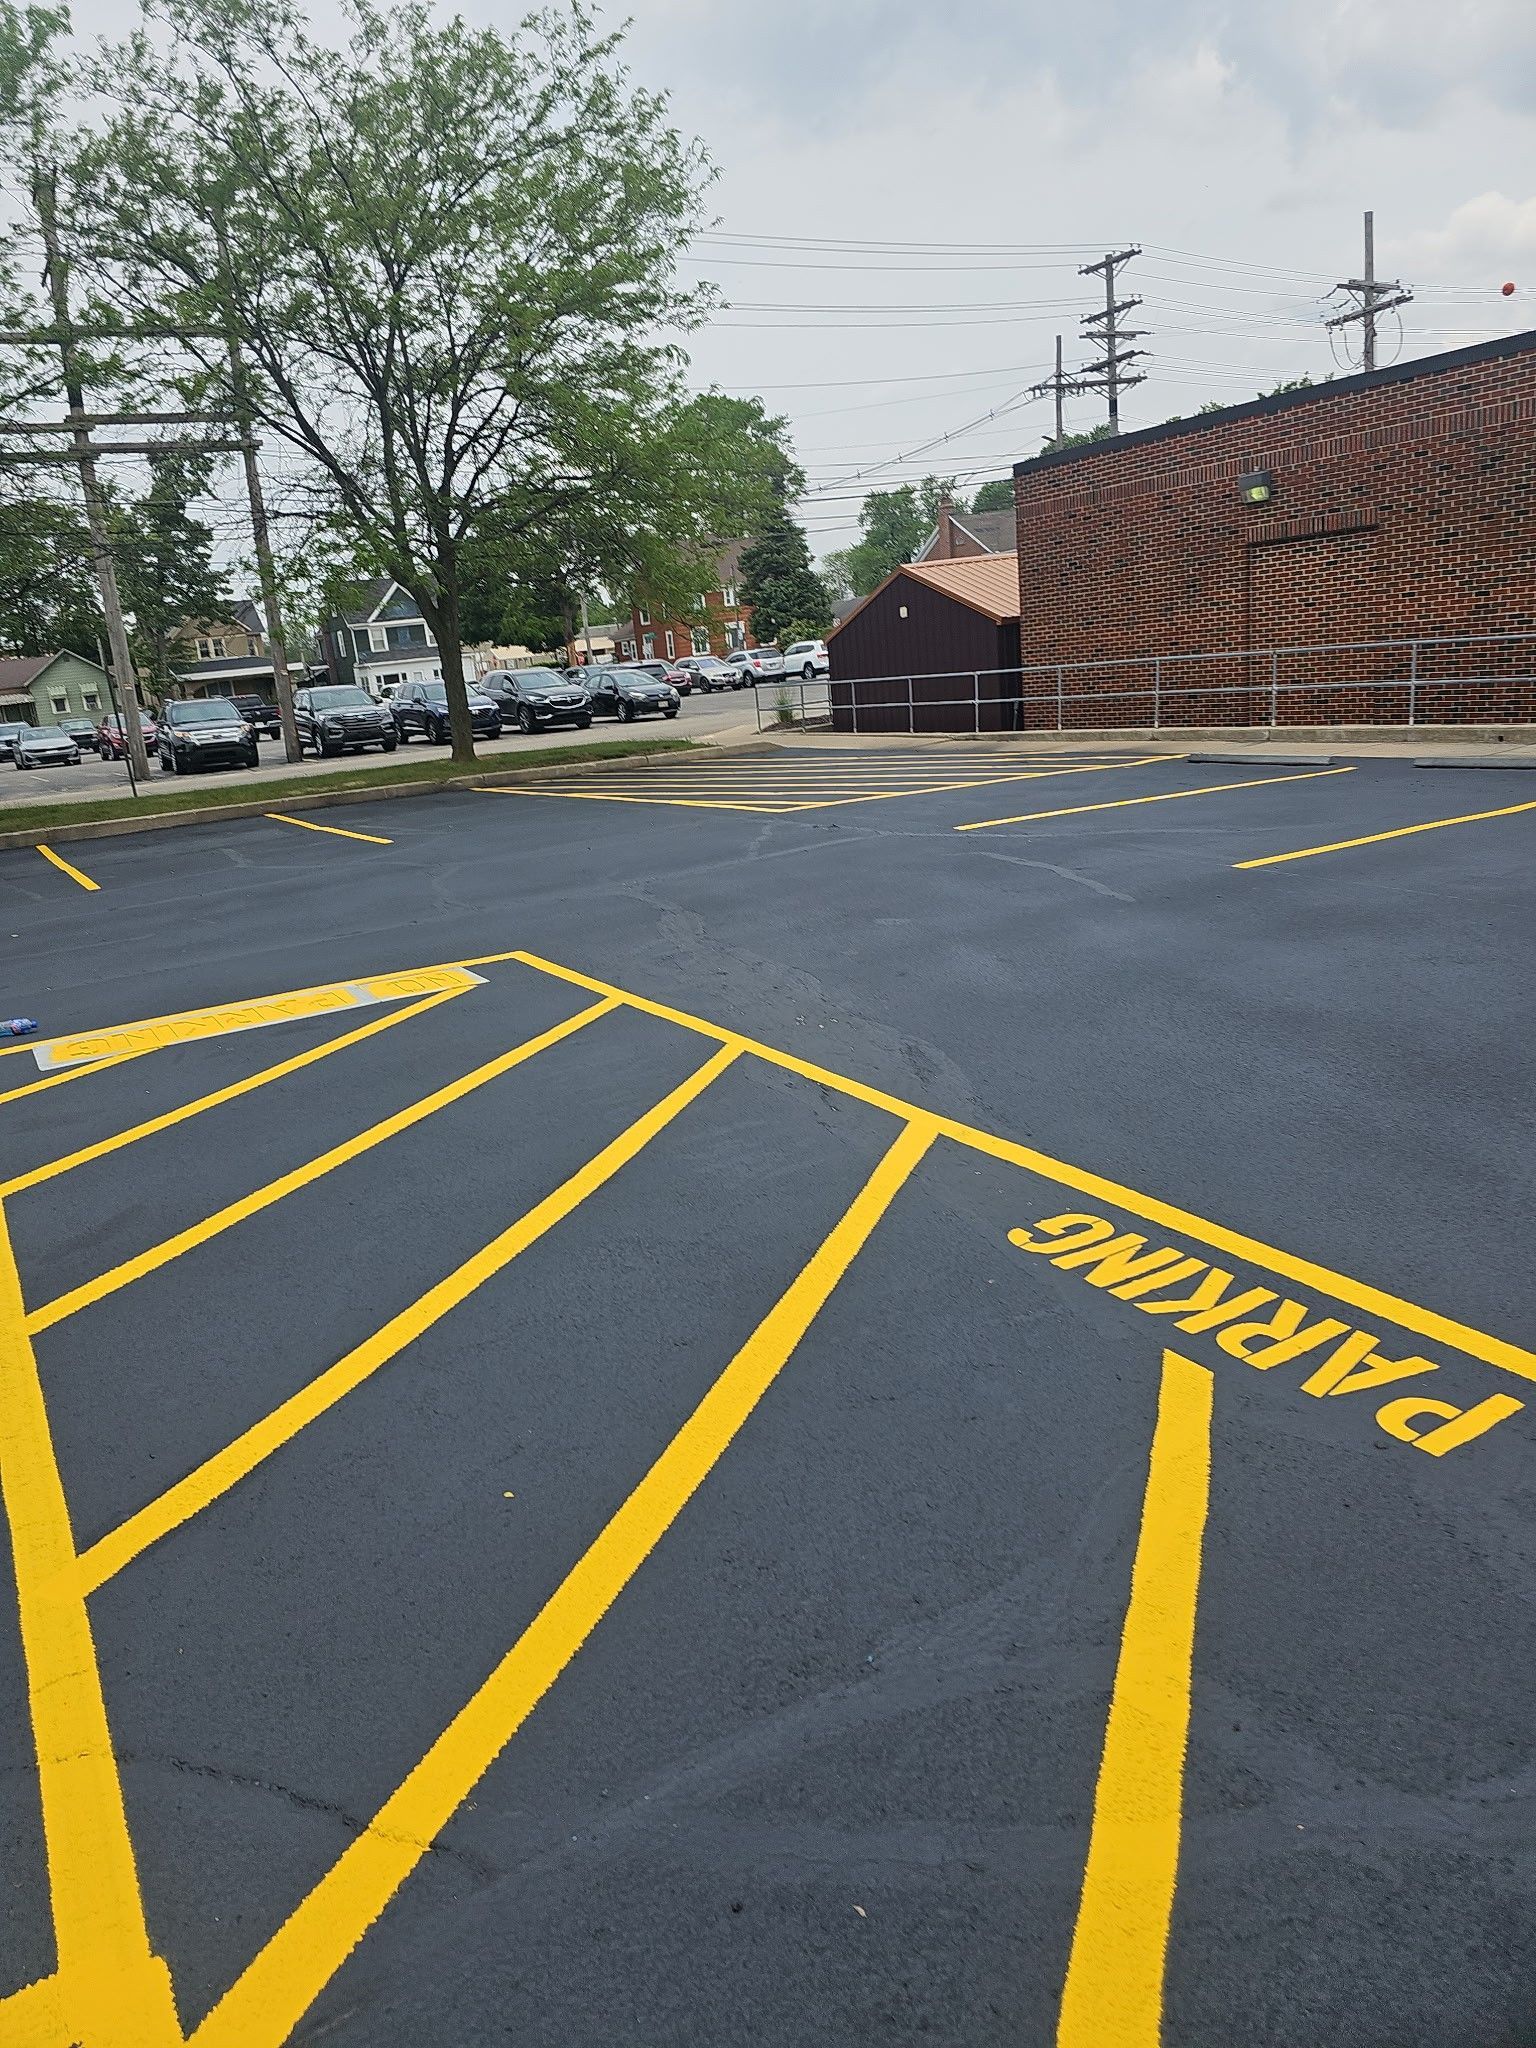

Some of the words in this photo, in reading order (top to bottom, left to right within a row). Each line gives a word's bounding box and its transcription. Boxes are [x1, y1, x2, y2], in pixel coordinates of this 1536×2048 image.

[384, 971, 463, 995] NO
[64, 990, 350, 1058] PARKING
[1007, 1213, 1525, 1457] PARKING
